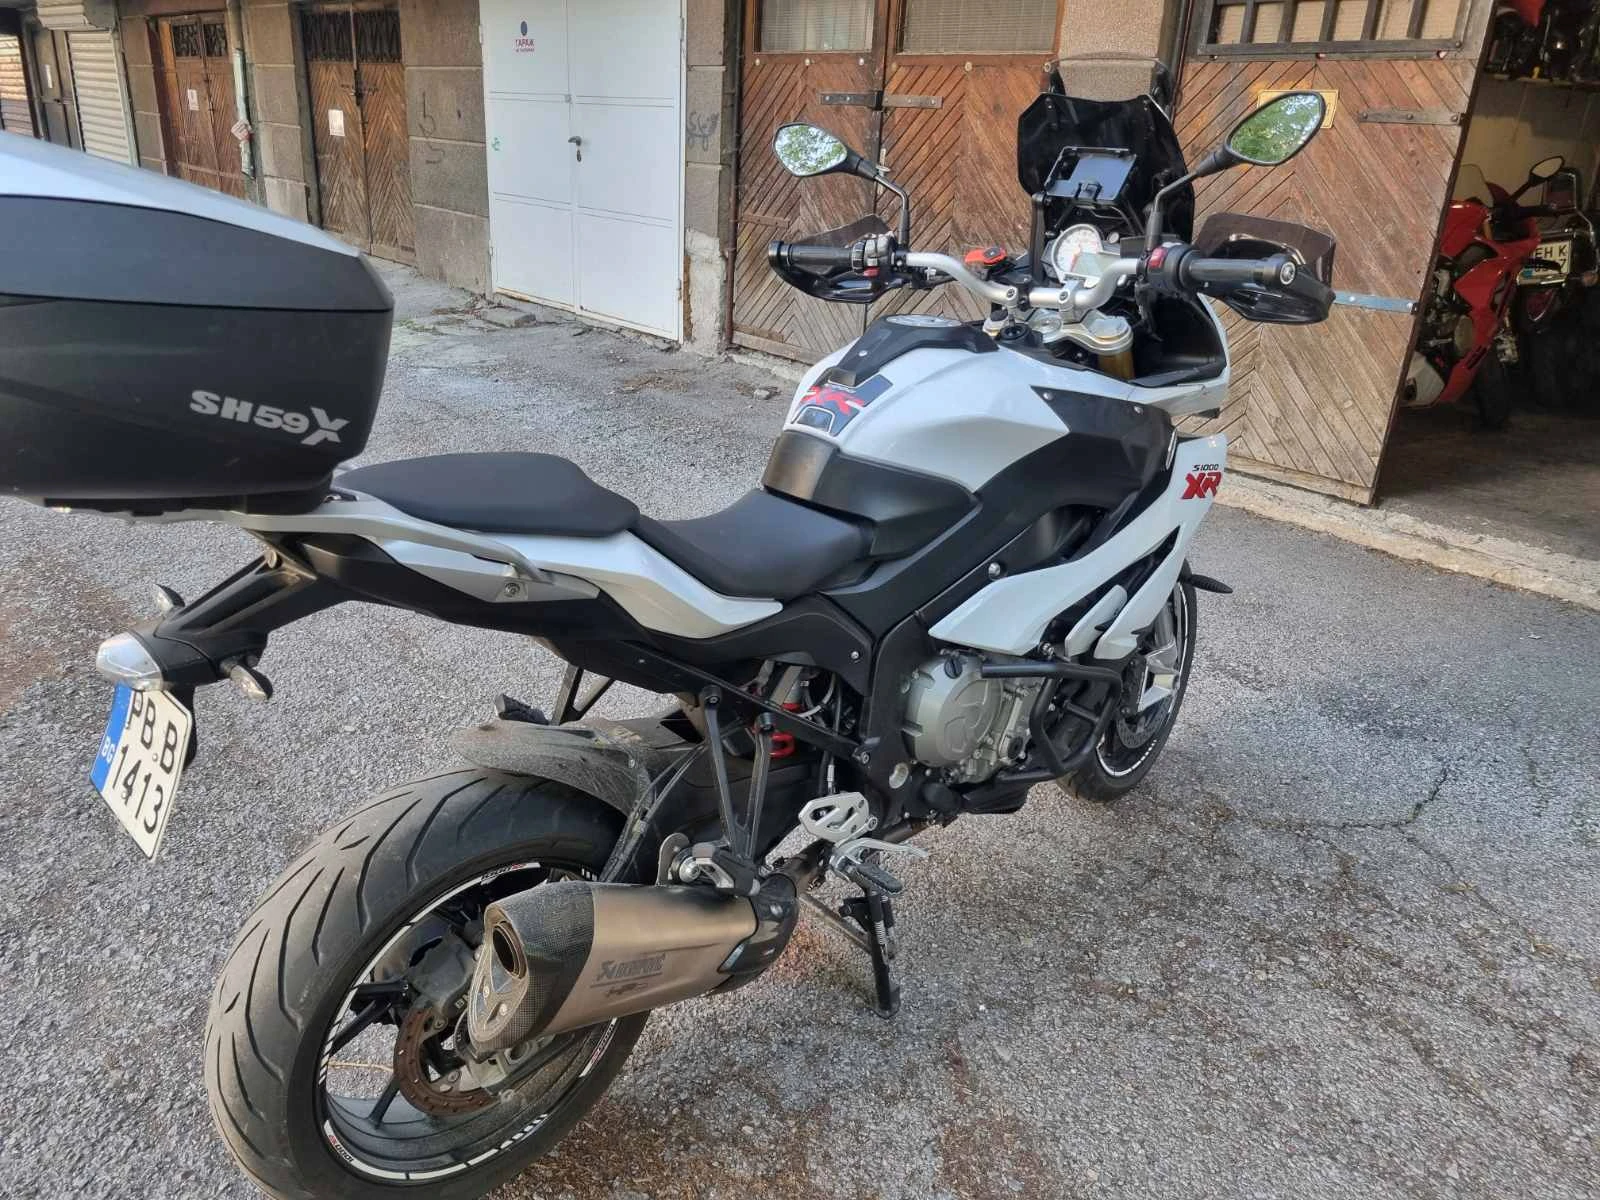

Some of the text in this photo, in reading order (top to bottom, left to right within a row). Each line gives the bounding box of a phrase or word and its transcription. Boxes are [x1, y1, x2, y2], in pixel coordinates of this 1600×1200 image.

[189, 389, 351, 446] SH59X
[1191, 463, 1219, 472] S1000
[1181, 471, 1222, 500] XR
[101, 734, 116, 764] BG
[112, 743, 163, 834] 1413
